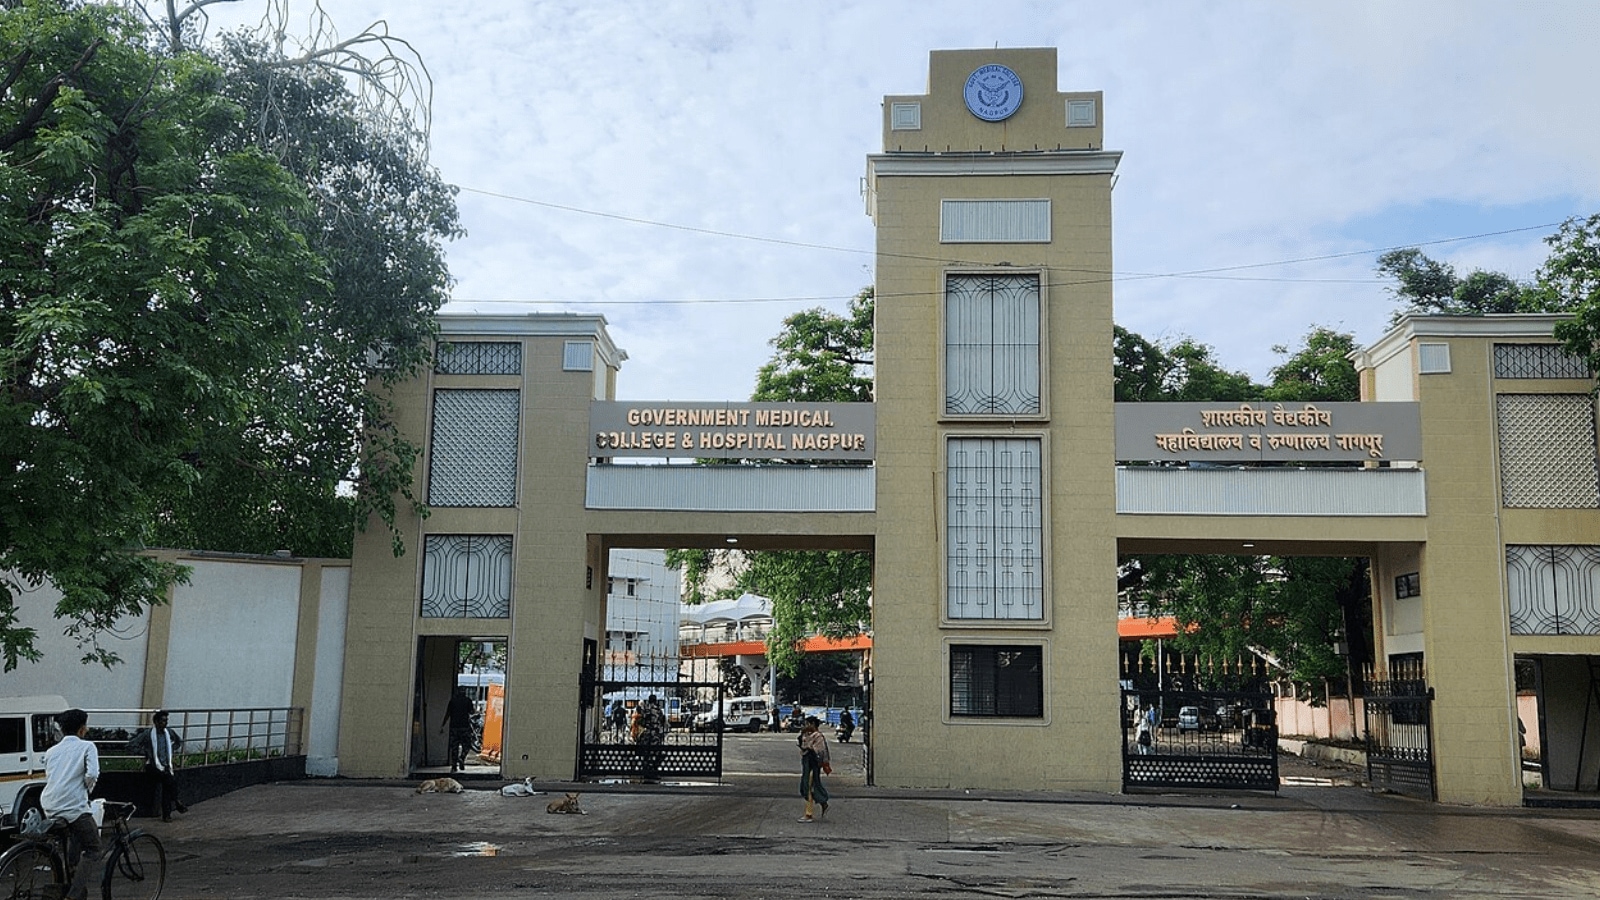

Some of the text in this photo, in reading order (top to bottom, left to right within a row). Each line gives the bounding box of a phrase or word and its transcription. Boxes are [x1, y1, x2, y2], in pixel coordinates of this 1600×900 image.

[979, 107, 1008, 116] NAGPUR
[627, 408, 834, 427] GOVERNMENT MEDICAL
[1200, 403, 1332, 427] शासकीय वैद्यकीय
[596, 431, 866, 452] COLLEGE & HOSPITAL NAGPUR
[1155, 427, 1384, 457] महाविद्यालय व रुग्णालय नागपूर
